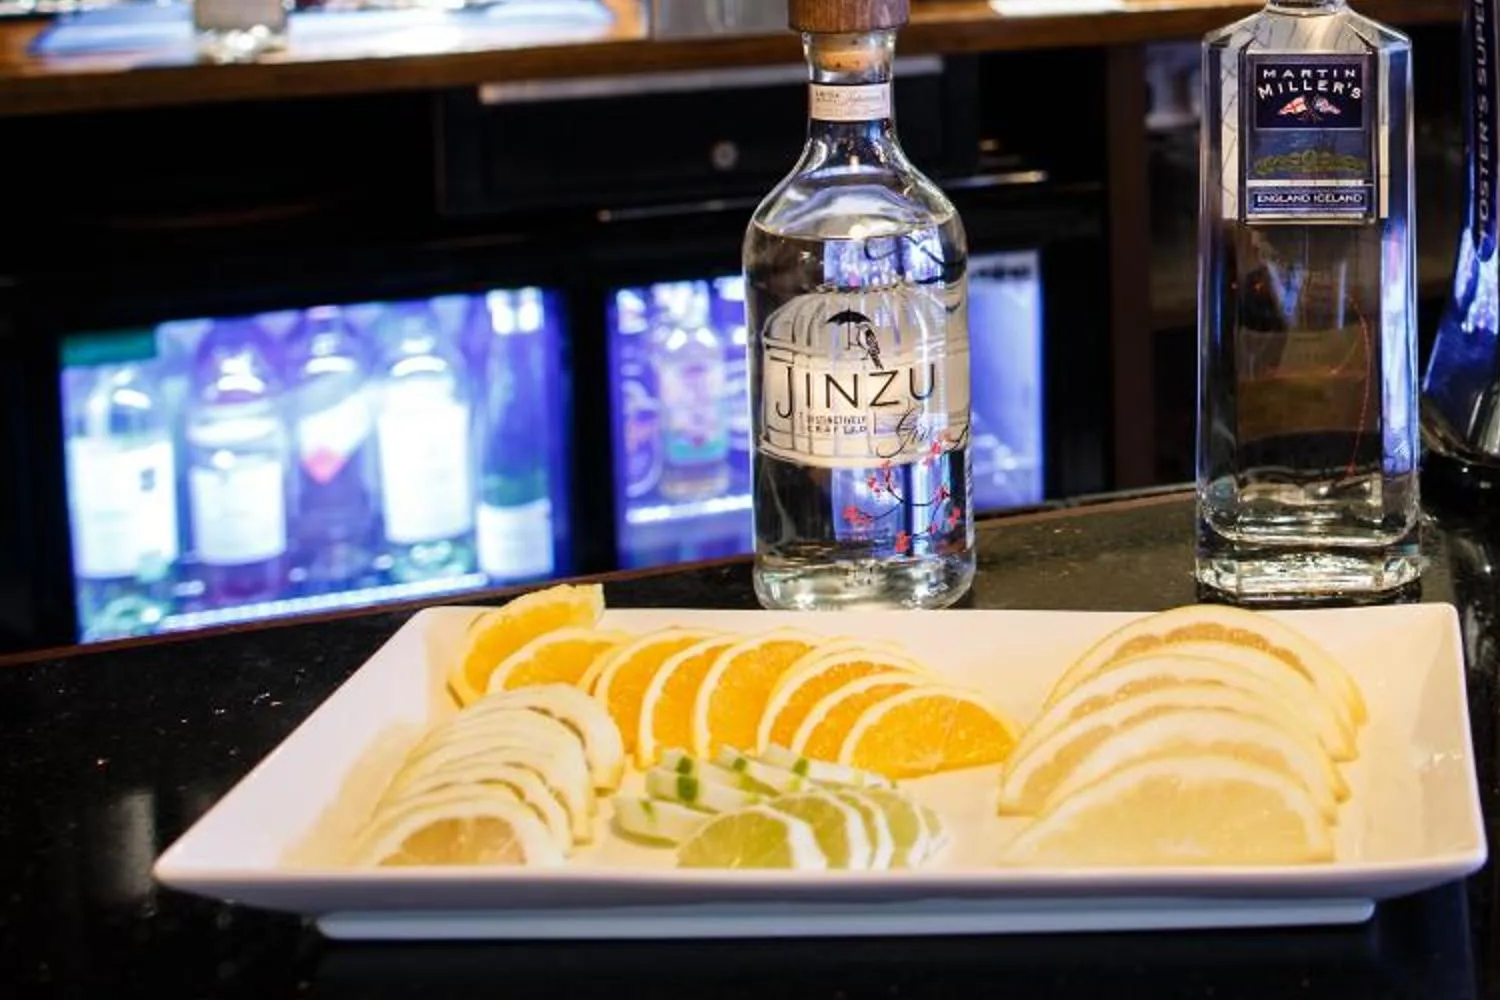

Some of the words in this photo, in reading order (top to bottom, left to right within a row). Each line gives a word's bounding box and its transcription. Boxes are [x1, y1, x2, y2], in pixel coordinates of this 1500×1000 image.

[1263, 68, 1356, 79] MARTIN
[1257, 80, 1362, 101] MILLER'S
[1477, 93, 1490, 237] FOSTER'S
[1257, 194, 1311, 203] ENGLAND
[1313, 194, 1363, 203] ICELAND
[776, 363, 935, 419] JINZU
